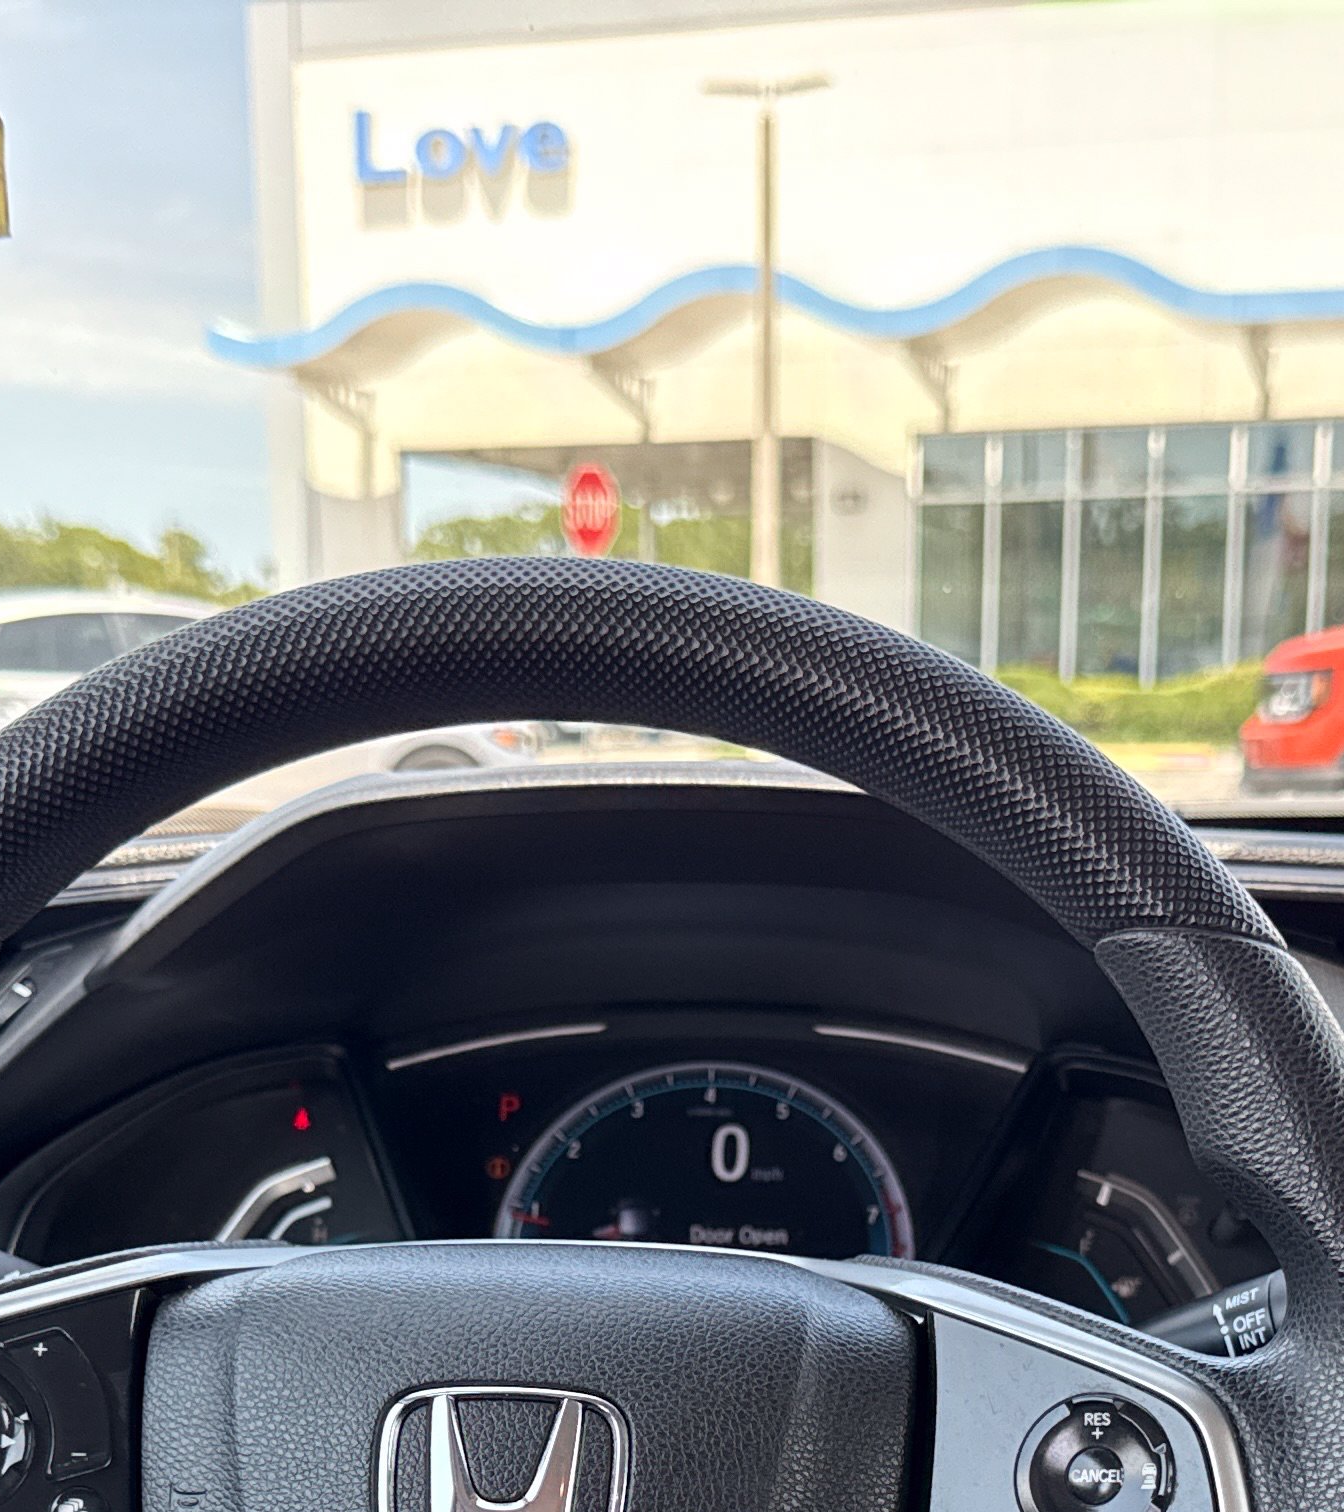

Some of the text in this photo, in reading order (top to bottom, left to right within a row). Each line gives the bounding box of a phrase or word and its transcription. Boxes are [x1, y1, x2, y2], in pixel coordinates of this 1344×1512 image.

[353, 110, 570, 184] Love
[499, 1091, 522, 1122] P
[711, 1122, 751, 1183] 0
[689, 1223, 790, 1246] Door Open
[1225, 1287, 1260, 1311] MIST
[1232, 1308, 1266, 1334] OFF
[1237, 1326, 1266, 1352] INT
[1083, 1411, 1111, 1427] RES
[1071, 1468, 1125, 1484] CANCEL
